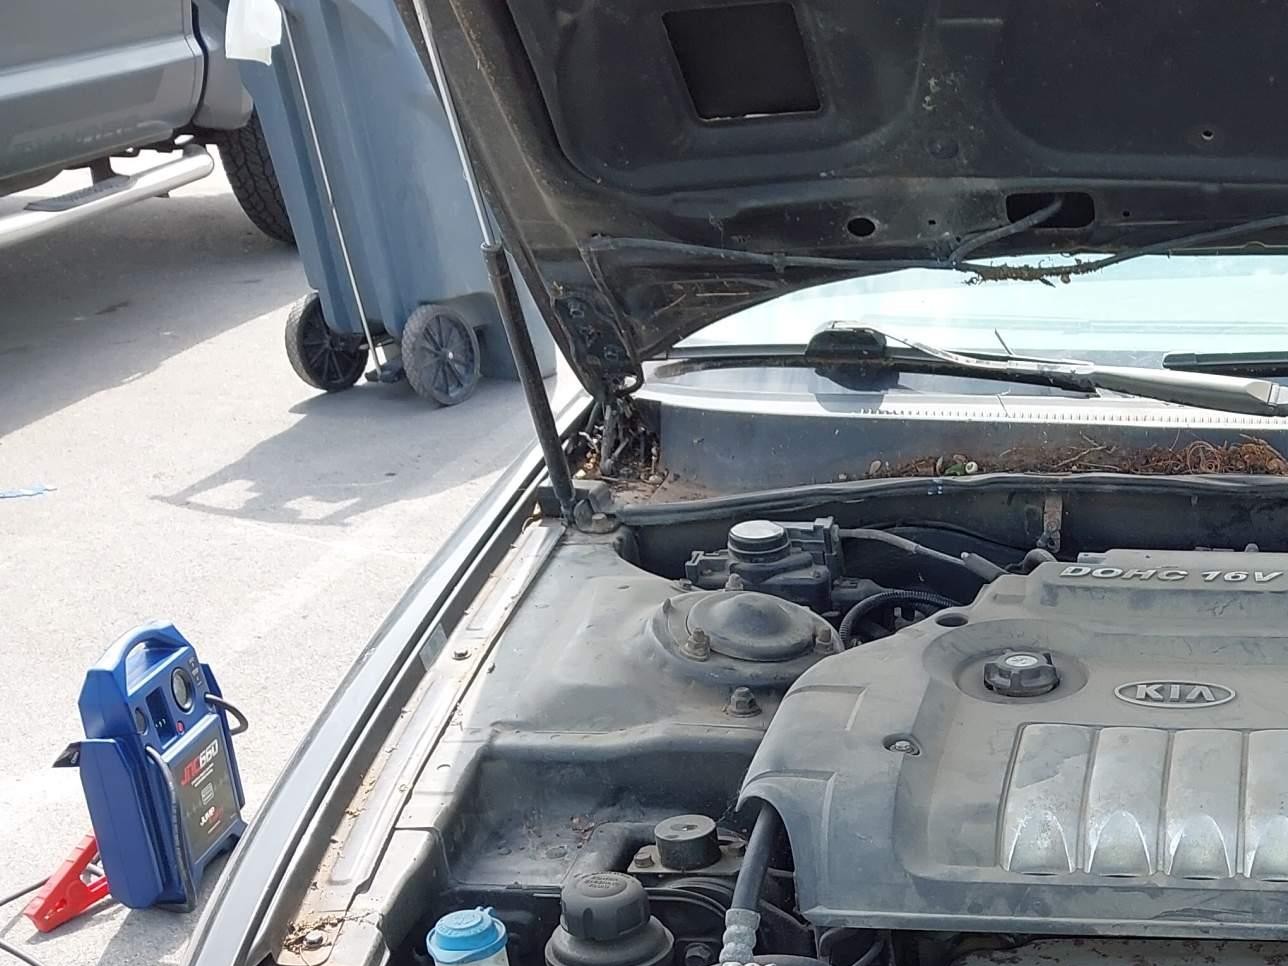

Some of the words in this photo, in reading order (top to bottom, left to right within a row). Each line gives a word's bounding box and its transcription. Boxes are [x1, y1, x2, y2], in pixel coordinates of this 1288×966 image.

[1059, 566, 1188, 581] DOHC
[1202, 569, 1284, 583] 16V
[1135, 684, 1216, 703] KIA
